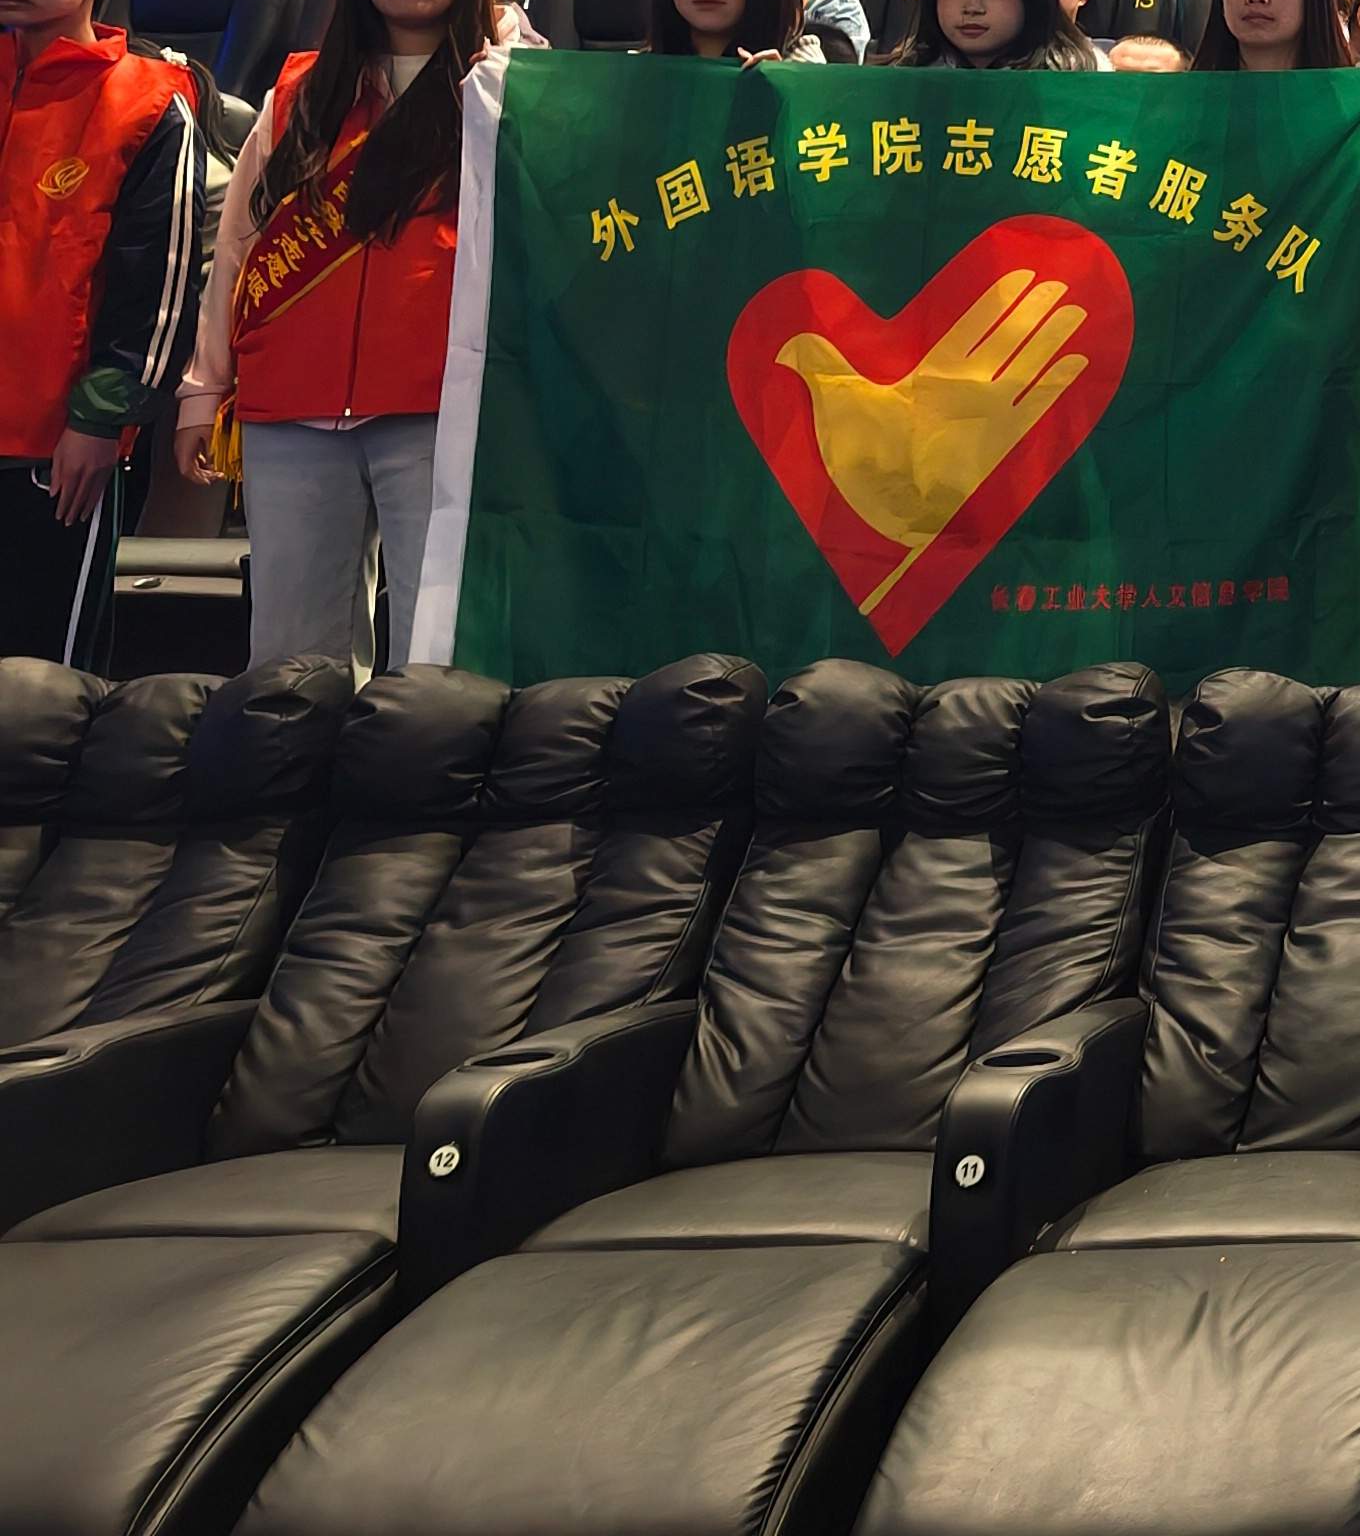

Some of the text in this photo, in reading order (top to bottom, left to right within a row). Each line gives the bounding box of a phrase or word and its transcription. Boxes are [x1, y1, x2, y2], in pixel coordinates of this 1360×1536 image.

[590, 116, 1324, 296] 外国语学院志愿者服务队
[433, 1152, 457, 1168] 12
[960, 1161, 979, 1180] 11
